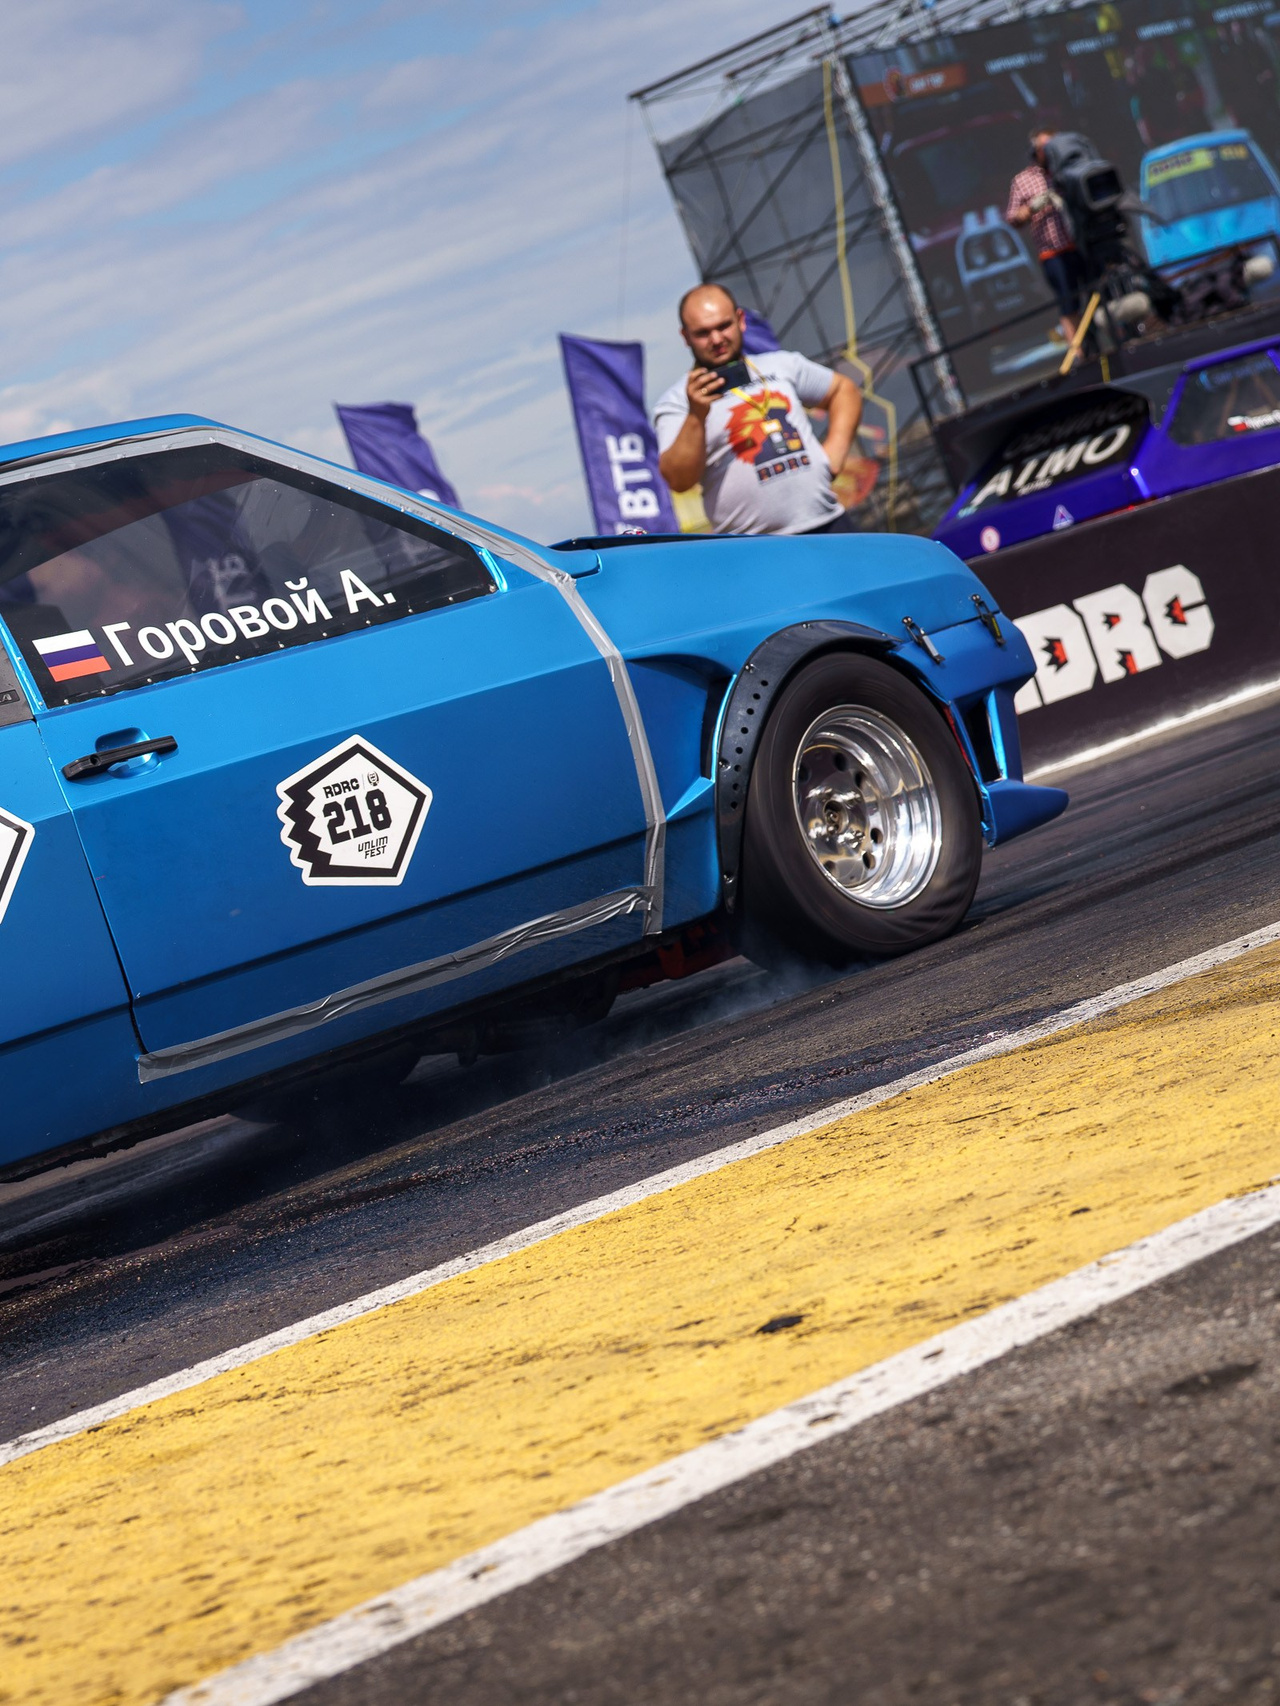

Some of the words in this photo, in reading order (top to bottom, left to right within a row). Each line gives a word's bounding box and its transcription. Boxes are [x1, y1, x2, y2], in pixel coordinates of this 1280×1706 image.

[605, 432, 660, 518] ВТБ
[758, 455, 811, 482] RDRC
[101, 576, 334, 666] Горовой
[339, 569, 397, 614] А.
[322, 778, 360, 799] RDRC
[322, 788, 392, 845] 218
[364, 845, 387, 860] FEST
